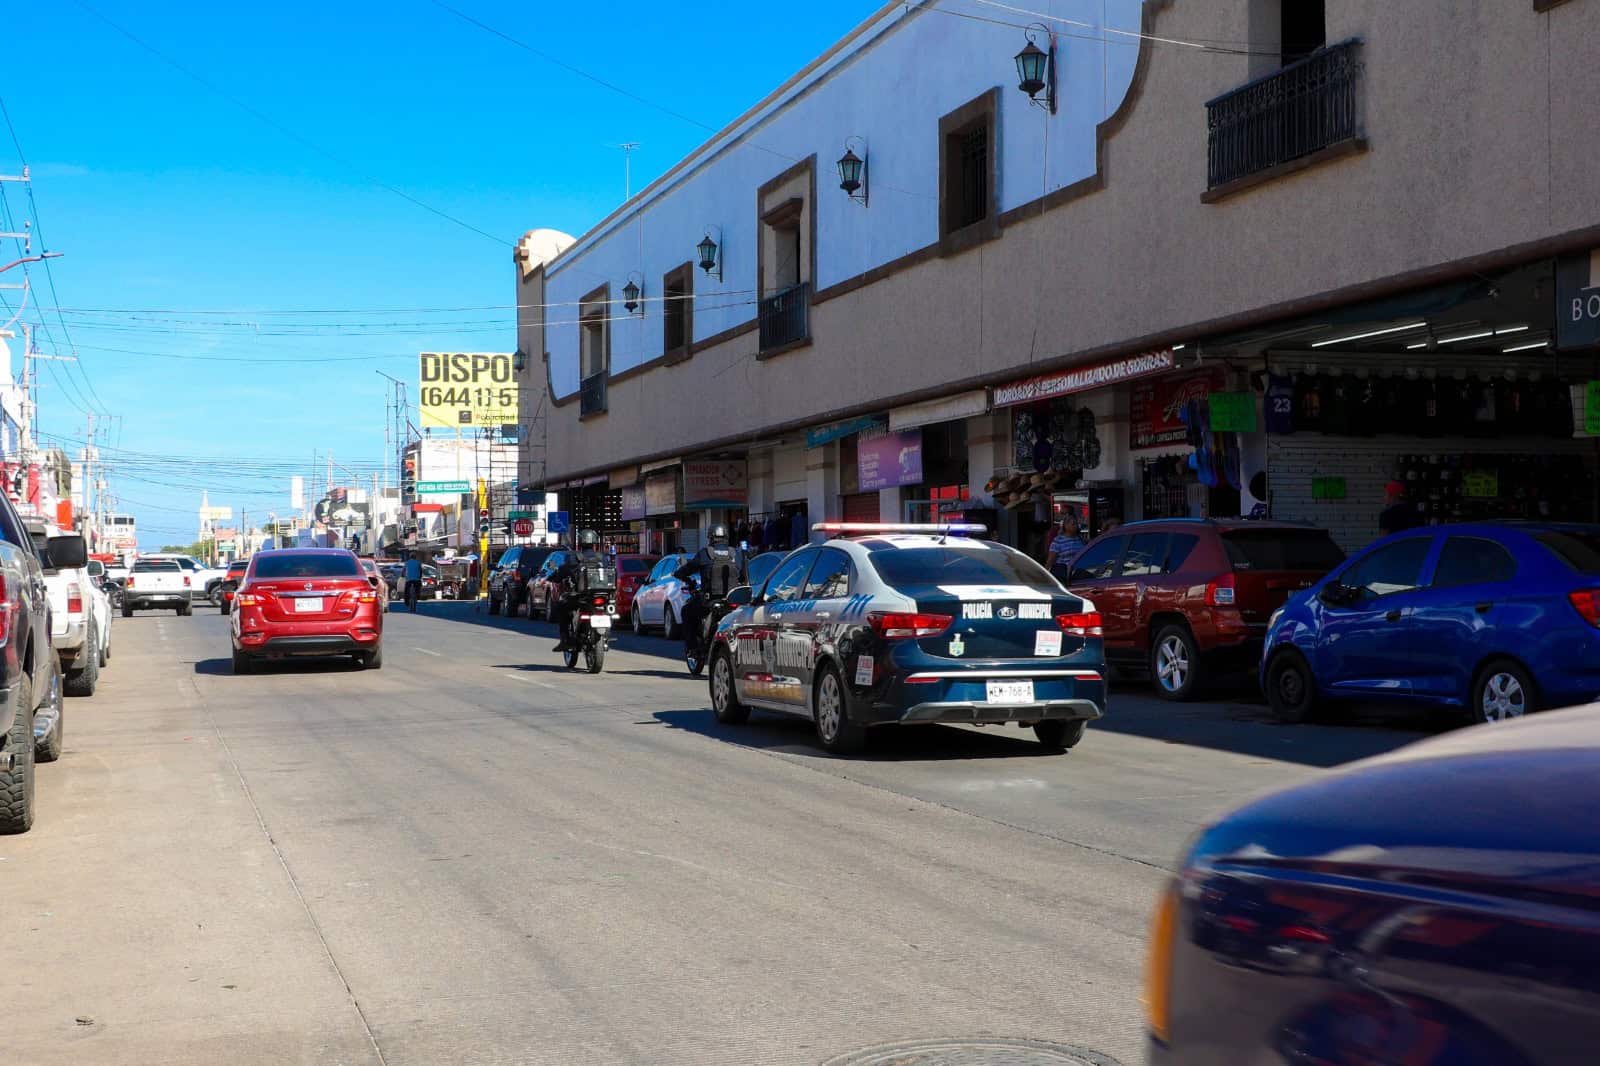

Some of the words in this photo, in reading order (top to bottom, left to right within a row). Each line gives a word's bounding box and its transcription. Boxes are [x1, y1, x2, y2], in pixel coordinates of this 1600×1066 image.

[1041, 366, 1114, 396] PERSONALIZADO
[1114, 362, 1127, 380] DE
[1273, 397, 1292, 413] 23
[515, 523, 532, 533] ALTO
[963, 601, 993, 619] POLICÍA
[1018, 603, 1052, 619] MUNICIPAL
